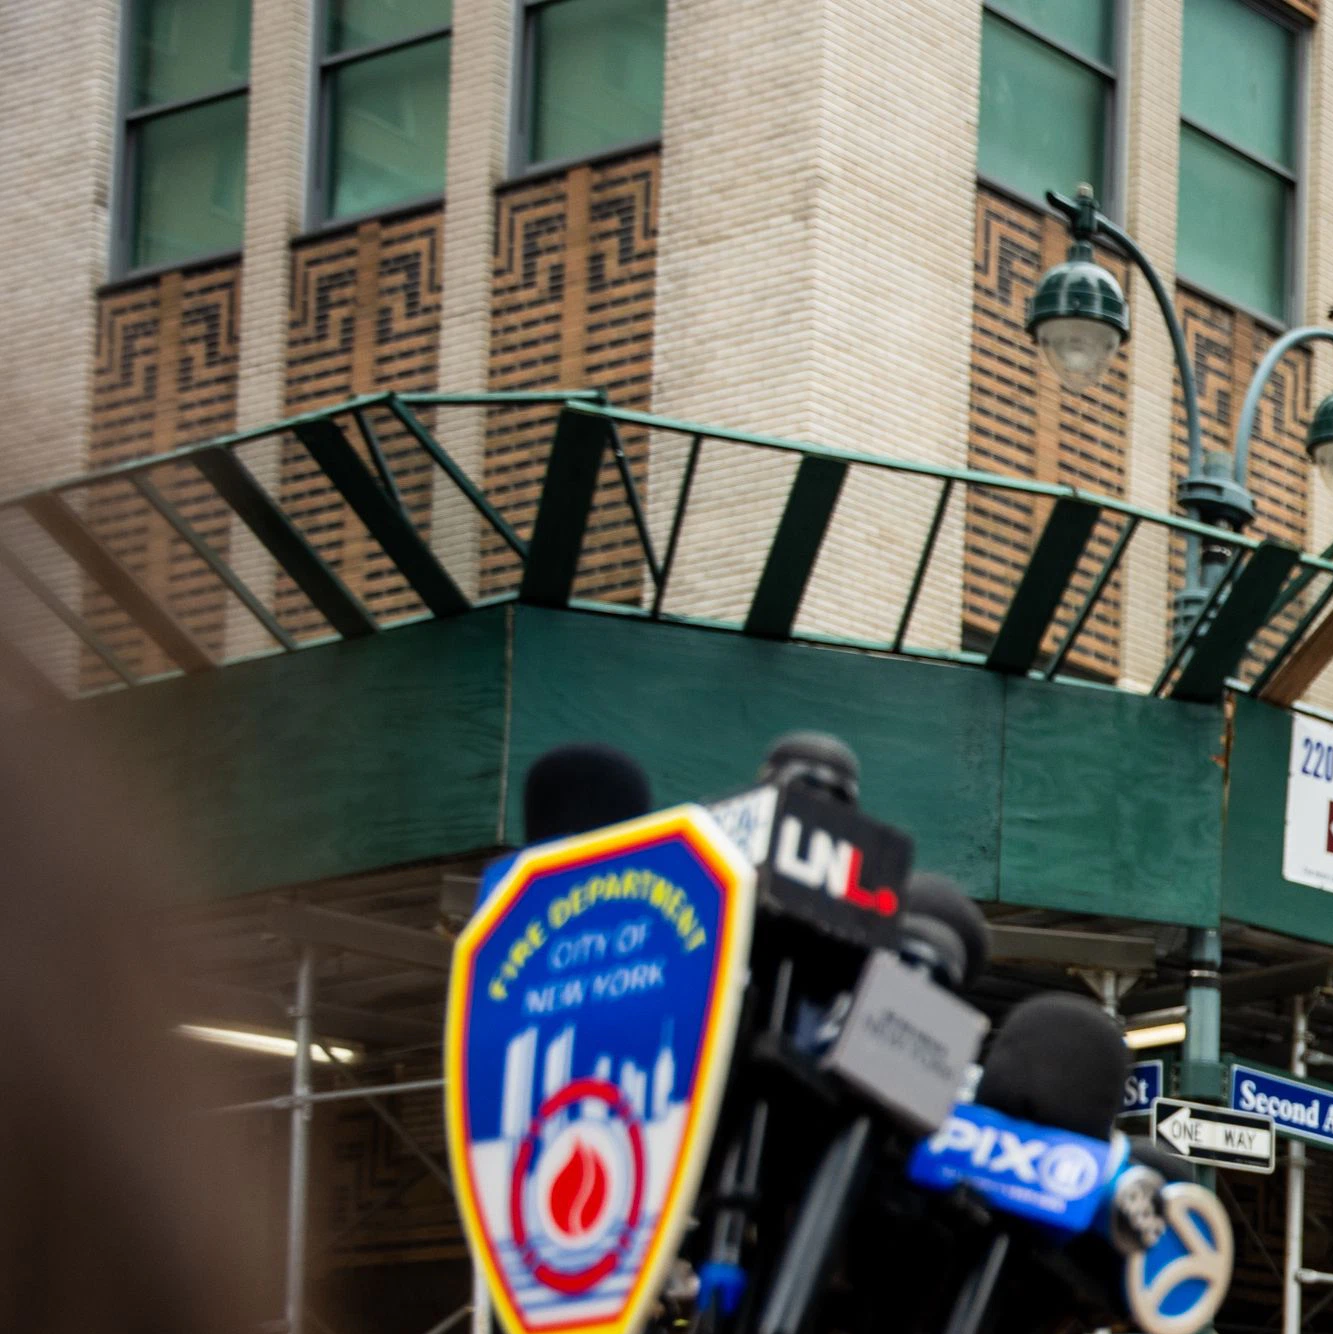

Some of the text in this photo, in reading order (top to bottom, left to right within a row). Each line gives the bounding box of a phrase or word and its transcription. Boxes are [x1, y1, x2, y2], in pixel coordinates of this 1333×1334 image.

[489, 867, 706, 1001] FIRE DEPARTMENT
[550, 921, 648, 969] CITY OF
[524, 963, 664, 1014] NEW YORK
[1123, 1074, 1149, 1106] St
[1239, 1079, 1320, 1130] Second
[1171, 1120, 1257, 1150] ONE WAY
